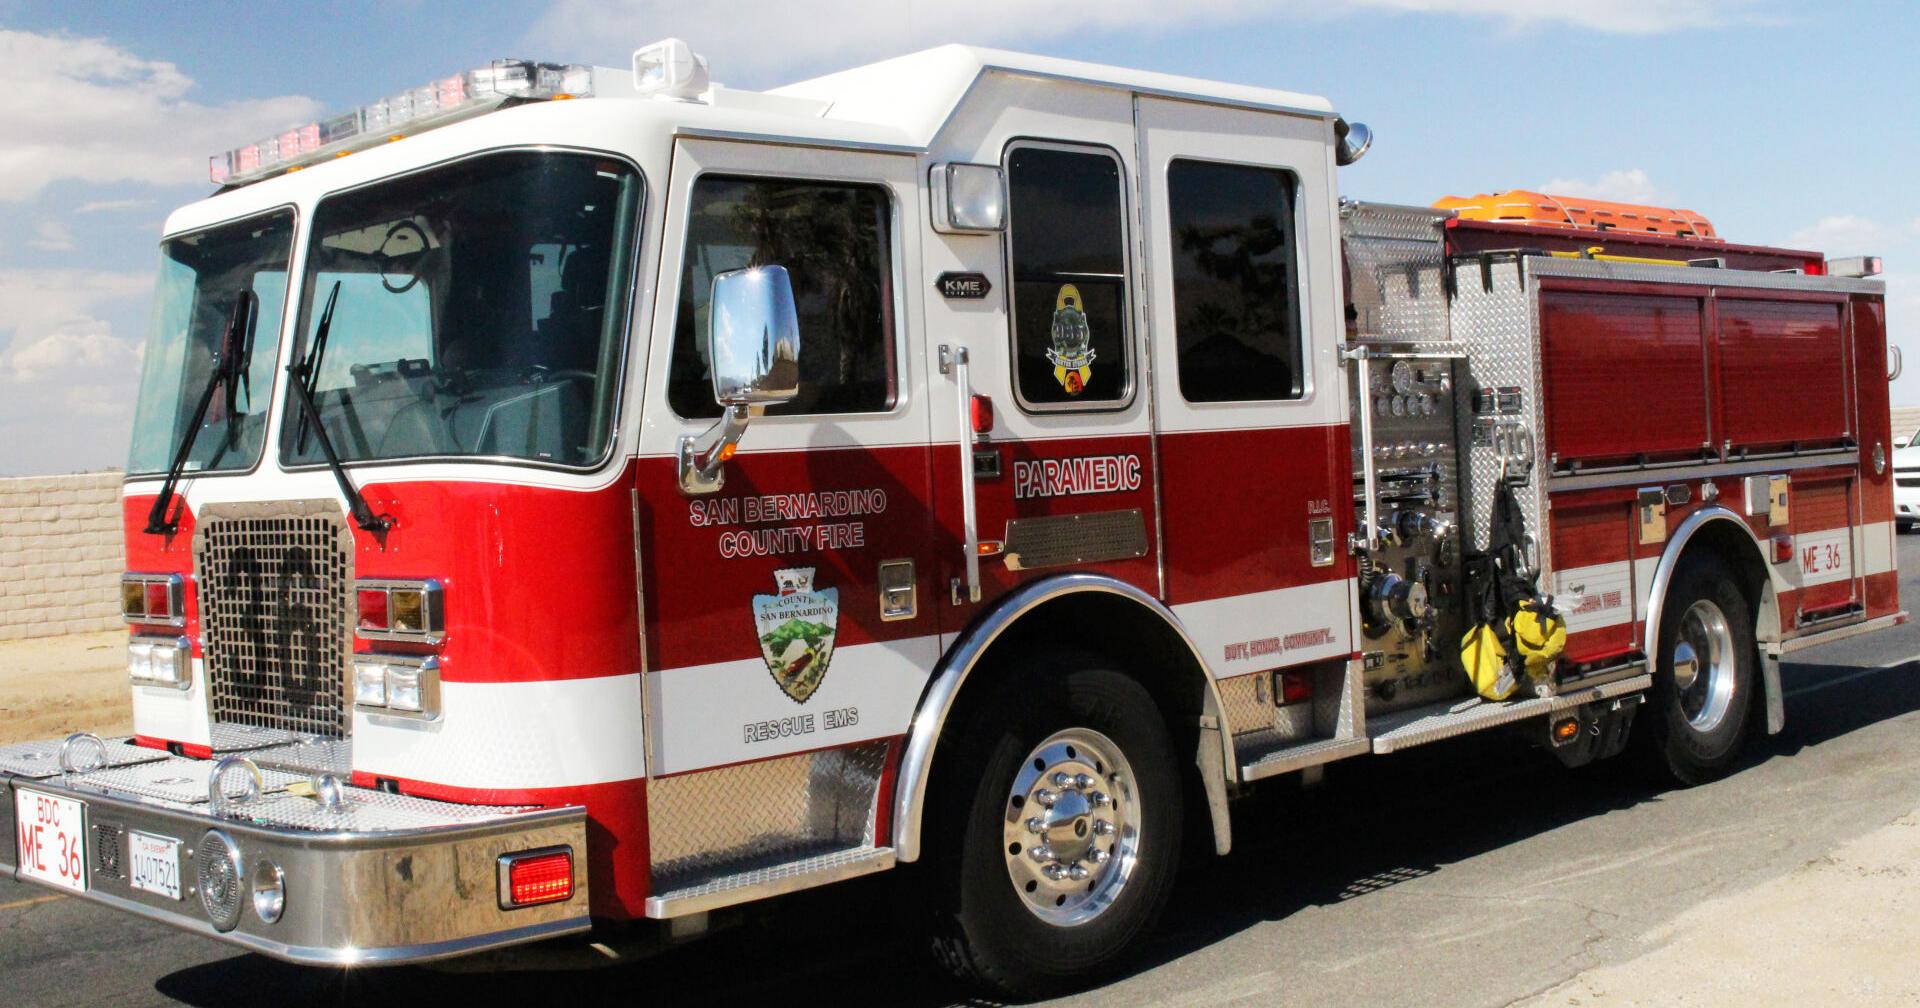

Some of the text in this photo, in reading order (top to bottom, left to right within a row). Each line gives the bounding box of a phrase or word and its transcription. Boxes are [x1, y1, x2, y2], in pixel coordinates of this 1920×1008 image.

[945, 280, 980, 291] KME
[1013, 454, 1141, 499] PARAMEDIC
[689, 489, 887, 527] SAN BERNARDINO
[719, 523, 865, 559] COUNTY FIRE
[1803, 544, 1841, 574] ME 36
[760, 606, 834, 622] SAN BERNARDINO
[744, 707, 859, 744] RESCUE EMS
[37, 796, 60, 827] BDC
[21, 821, 81, 881] ME 36
[135, 853, 178, 890] 1407521
